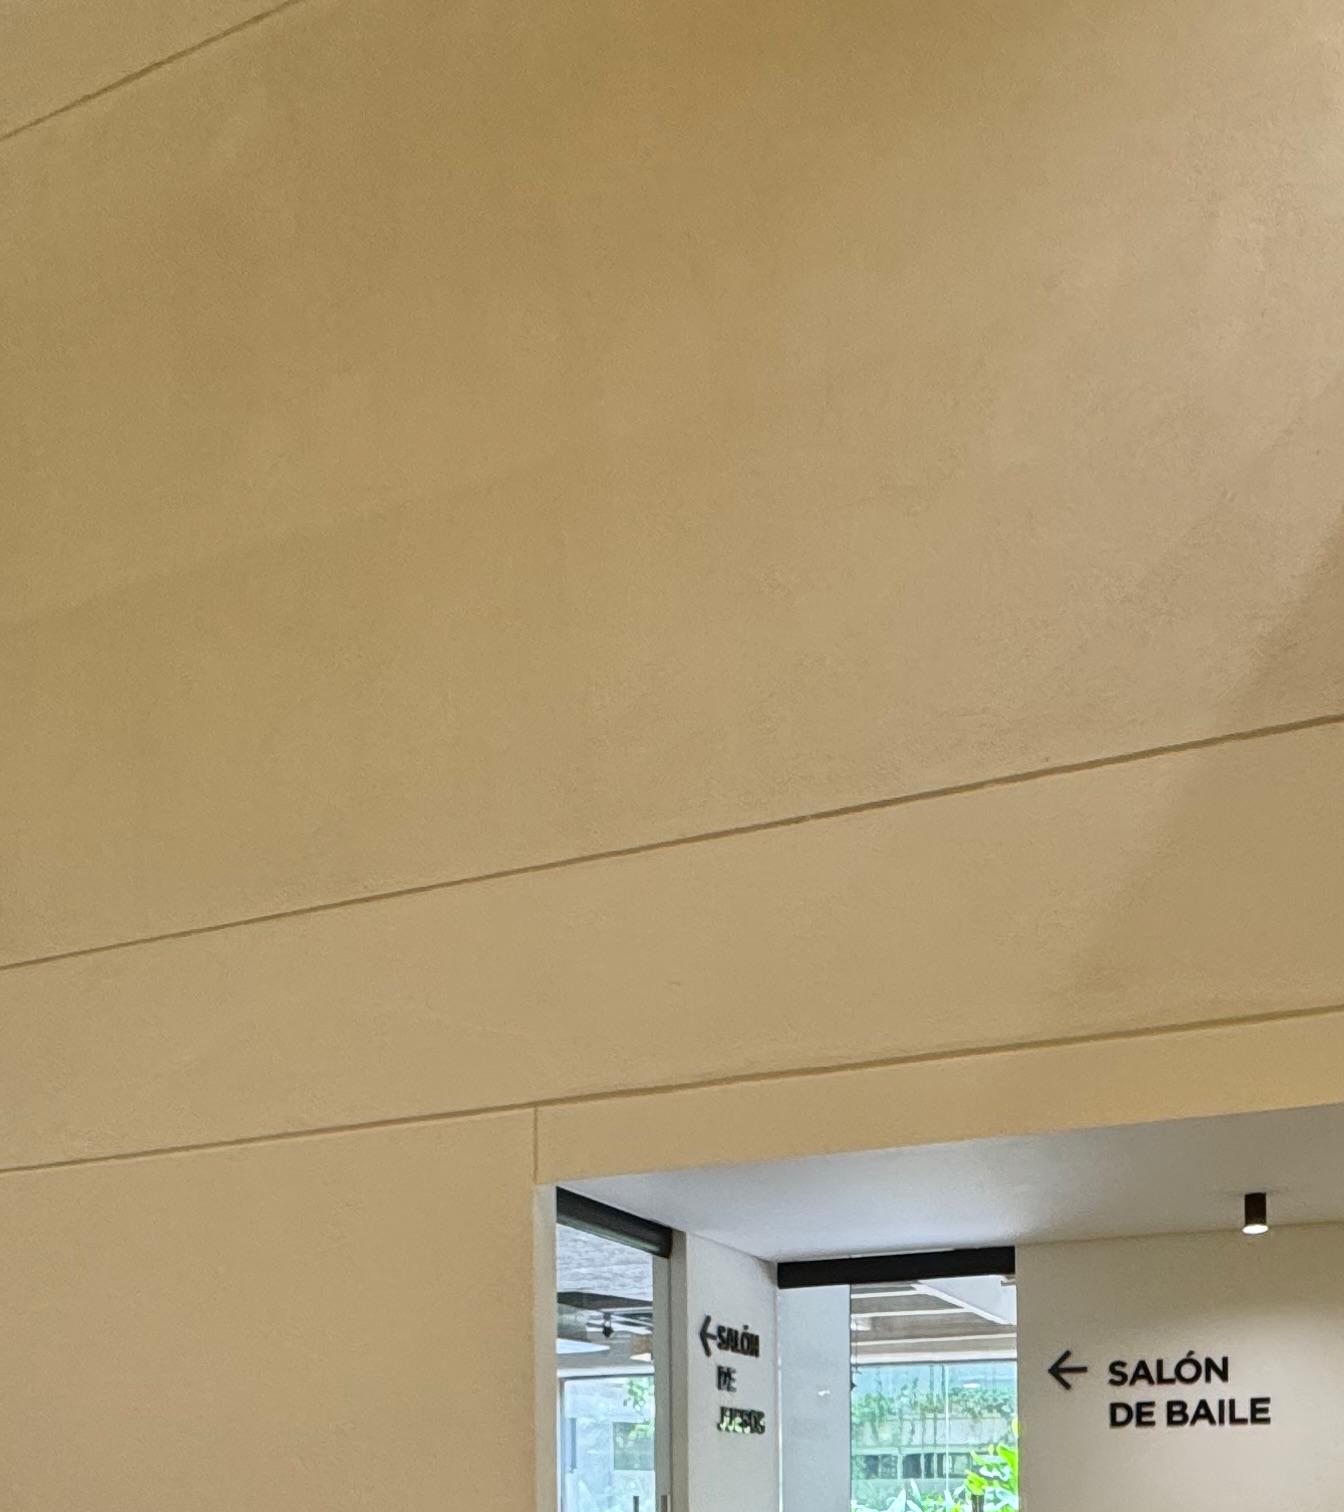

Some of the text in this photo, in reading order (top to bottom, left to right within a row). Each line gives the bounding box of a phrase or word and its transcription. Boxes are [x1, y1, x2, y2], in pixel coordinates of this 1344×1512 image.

[716, 1324, 760, 1358] SALÓN
[717, 1365, 737, 1392] DE
[1108, 1350, 1229, 1386] SALÓN
[1109, 1397, 1271, 1429] DE BAILE
